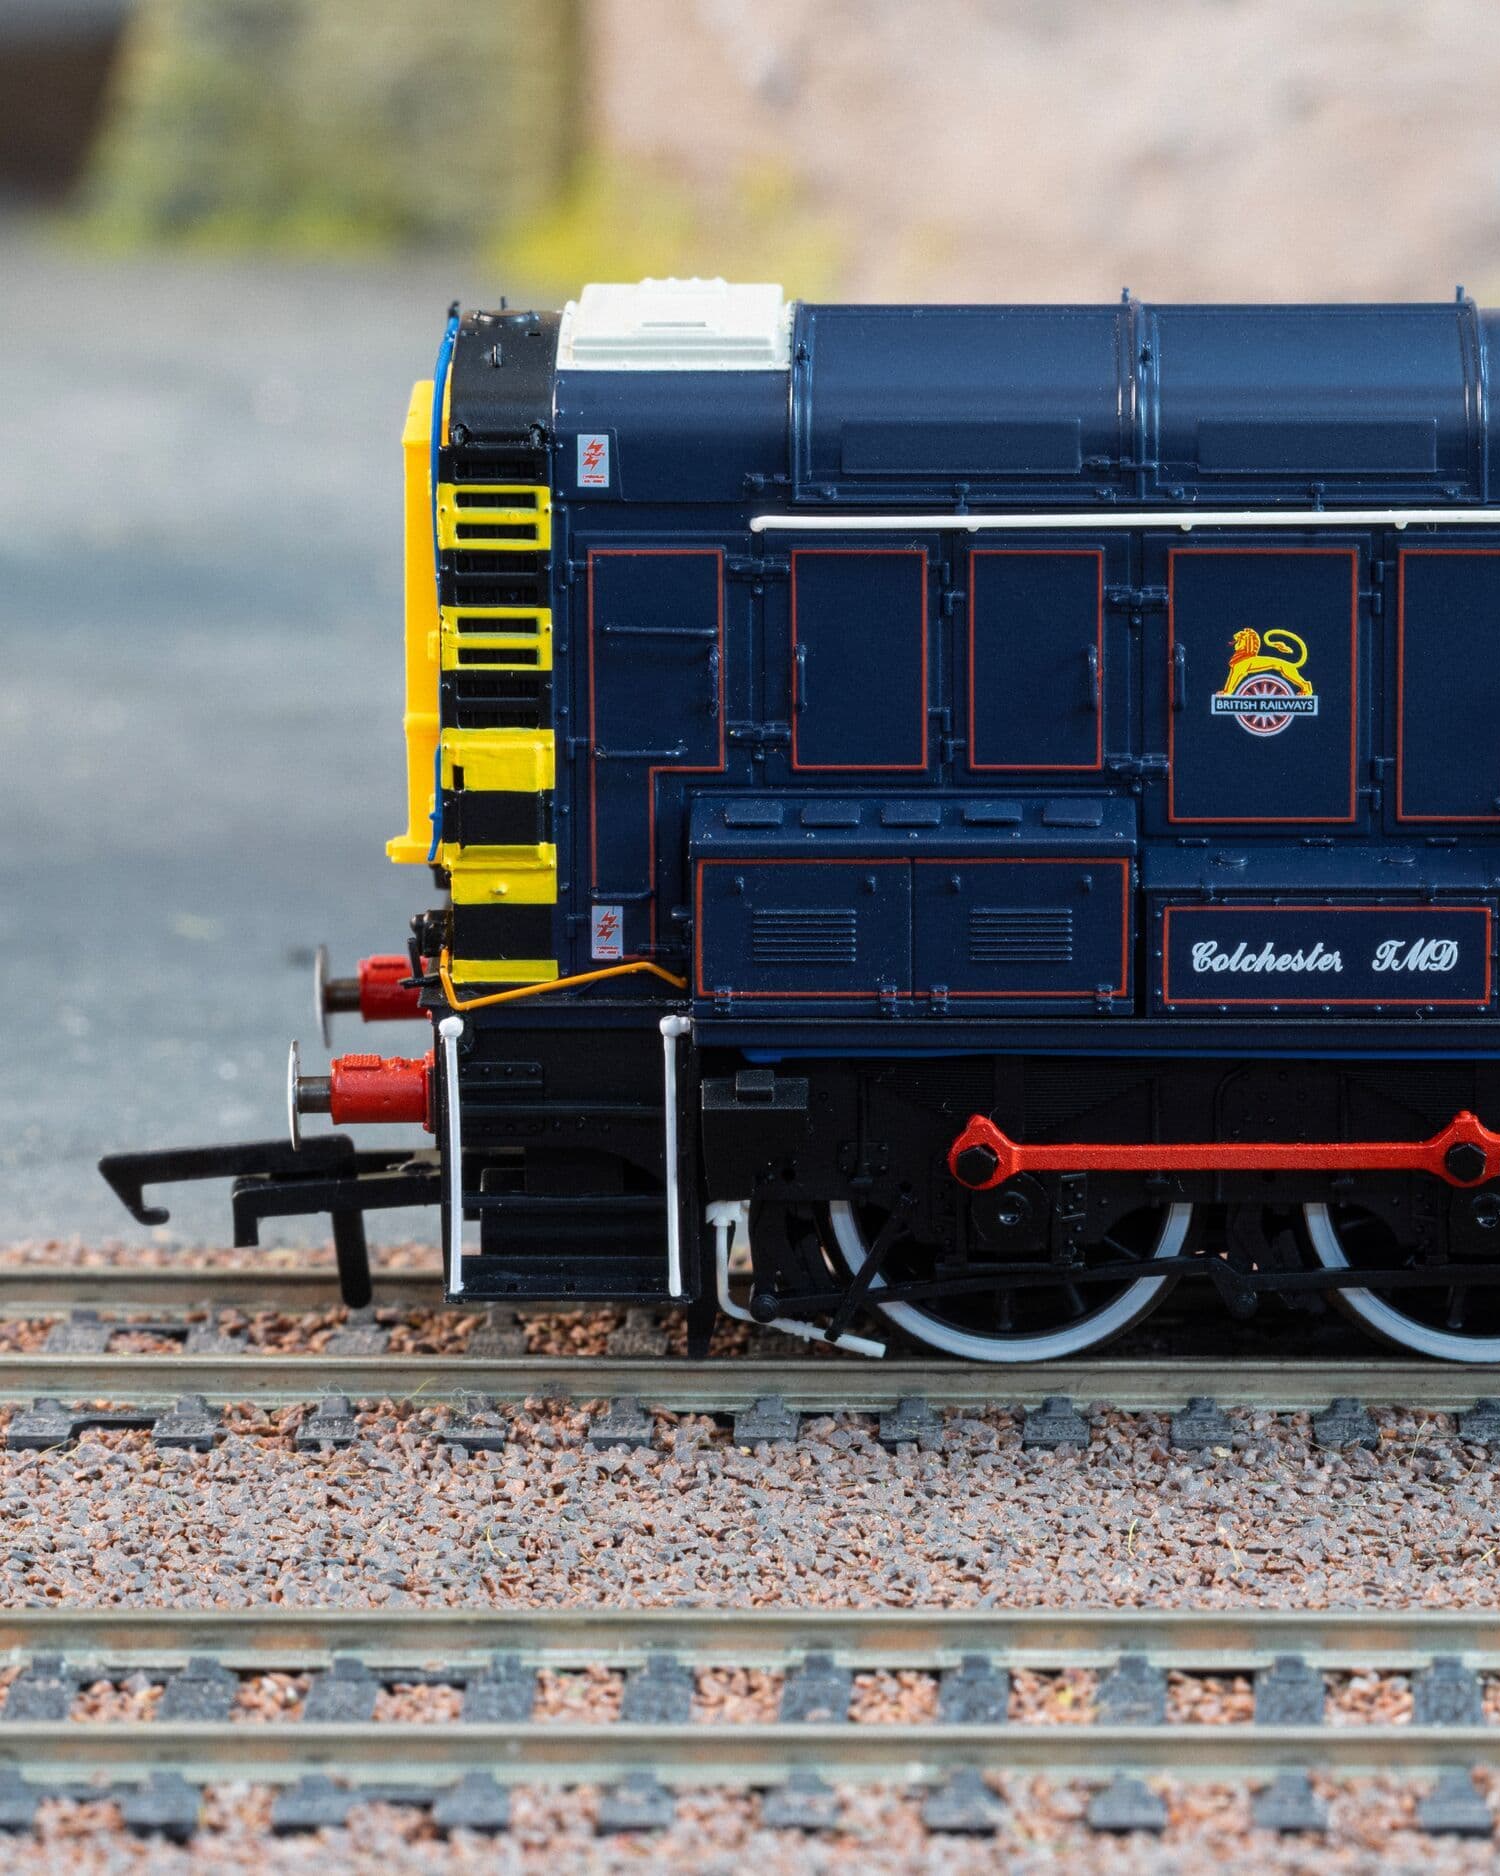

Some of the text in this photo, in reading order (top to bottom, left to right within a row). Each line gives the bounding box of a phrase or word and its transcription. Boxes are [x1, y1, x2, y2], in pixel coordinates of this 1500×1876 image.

[1216, 700, 1313, 710] BRITISH RAILWAYS
[1191, 937, 1459, 972] Colchester TMD
